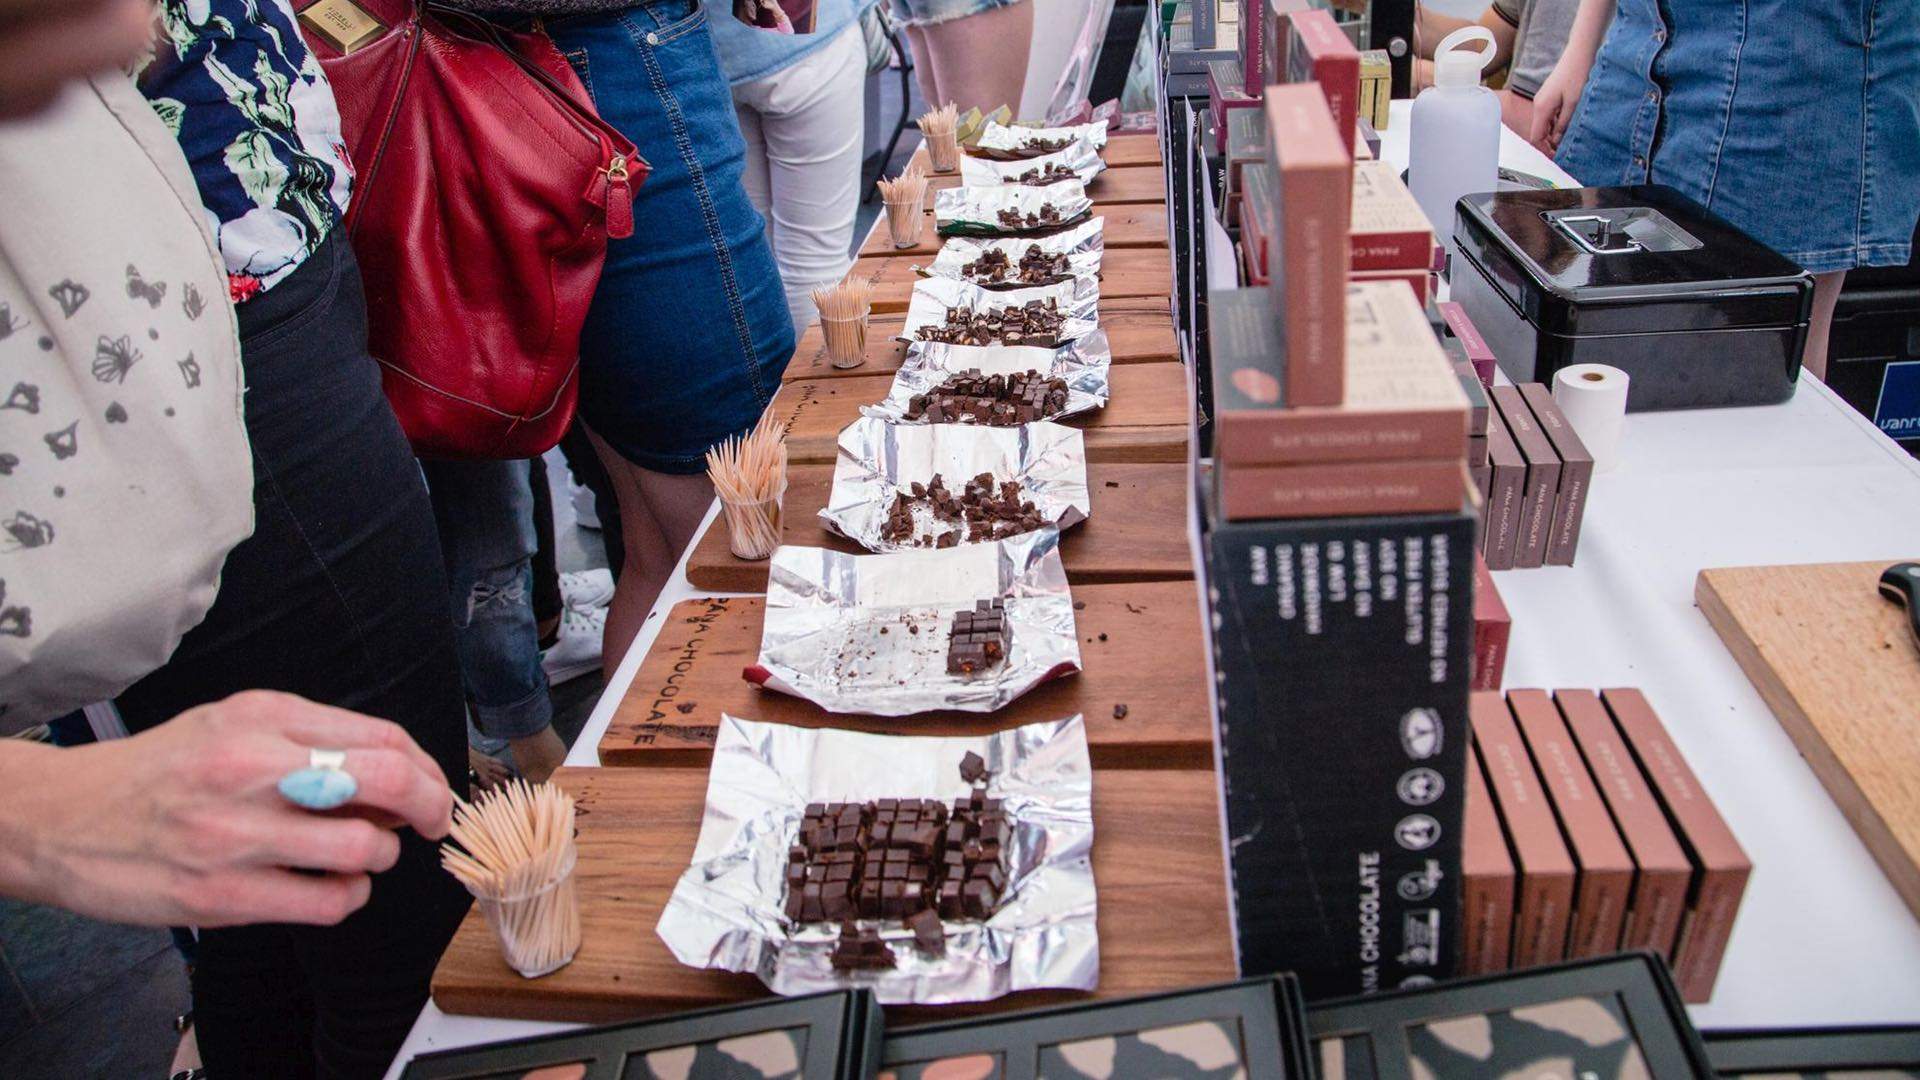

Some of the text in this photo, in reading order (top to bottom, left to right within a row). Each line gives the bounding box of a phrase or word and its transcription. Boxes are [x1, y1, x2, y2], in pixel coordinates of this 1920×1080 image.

[1497, 486, 1515, 551] PANA CHOCOLATE
[1528, 483, 1548, 549] PANA CHOCOLATE
[1560, 480, 1580, 546] PANA CHOCOLATE
[1251, 545, 1269, 585] RAW
[1275, 543, 1296, 619] ORGANIC
[1300, 541, 1323, 635] HANDMADE
[1328, 563, 1346, 602] LOW
[1353, 539, 1372, 618] NO DAIRY
[1379, 538, 1397, 601] NO SOY
[1404, 536, 1423, 645] GLUTEN FREE
[1430, 533, 1449, 683] NO REFINED SUGAR
[633, 638, 703, 745] CHOCOLATE
[1359, 851, 1380, 963] CHOCOLATE
